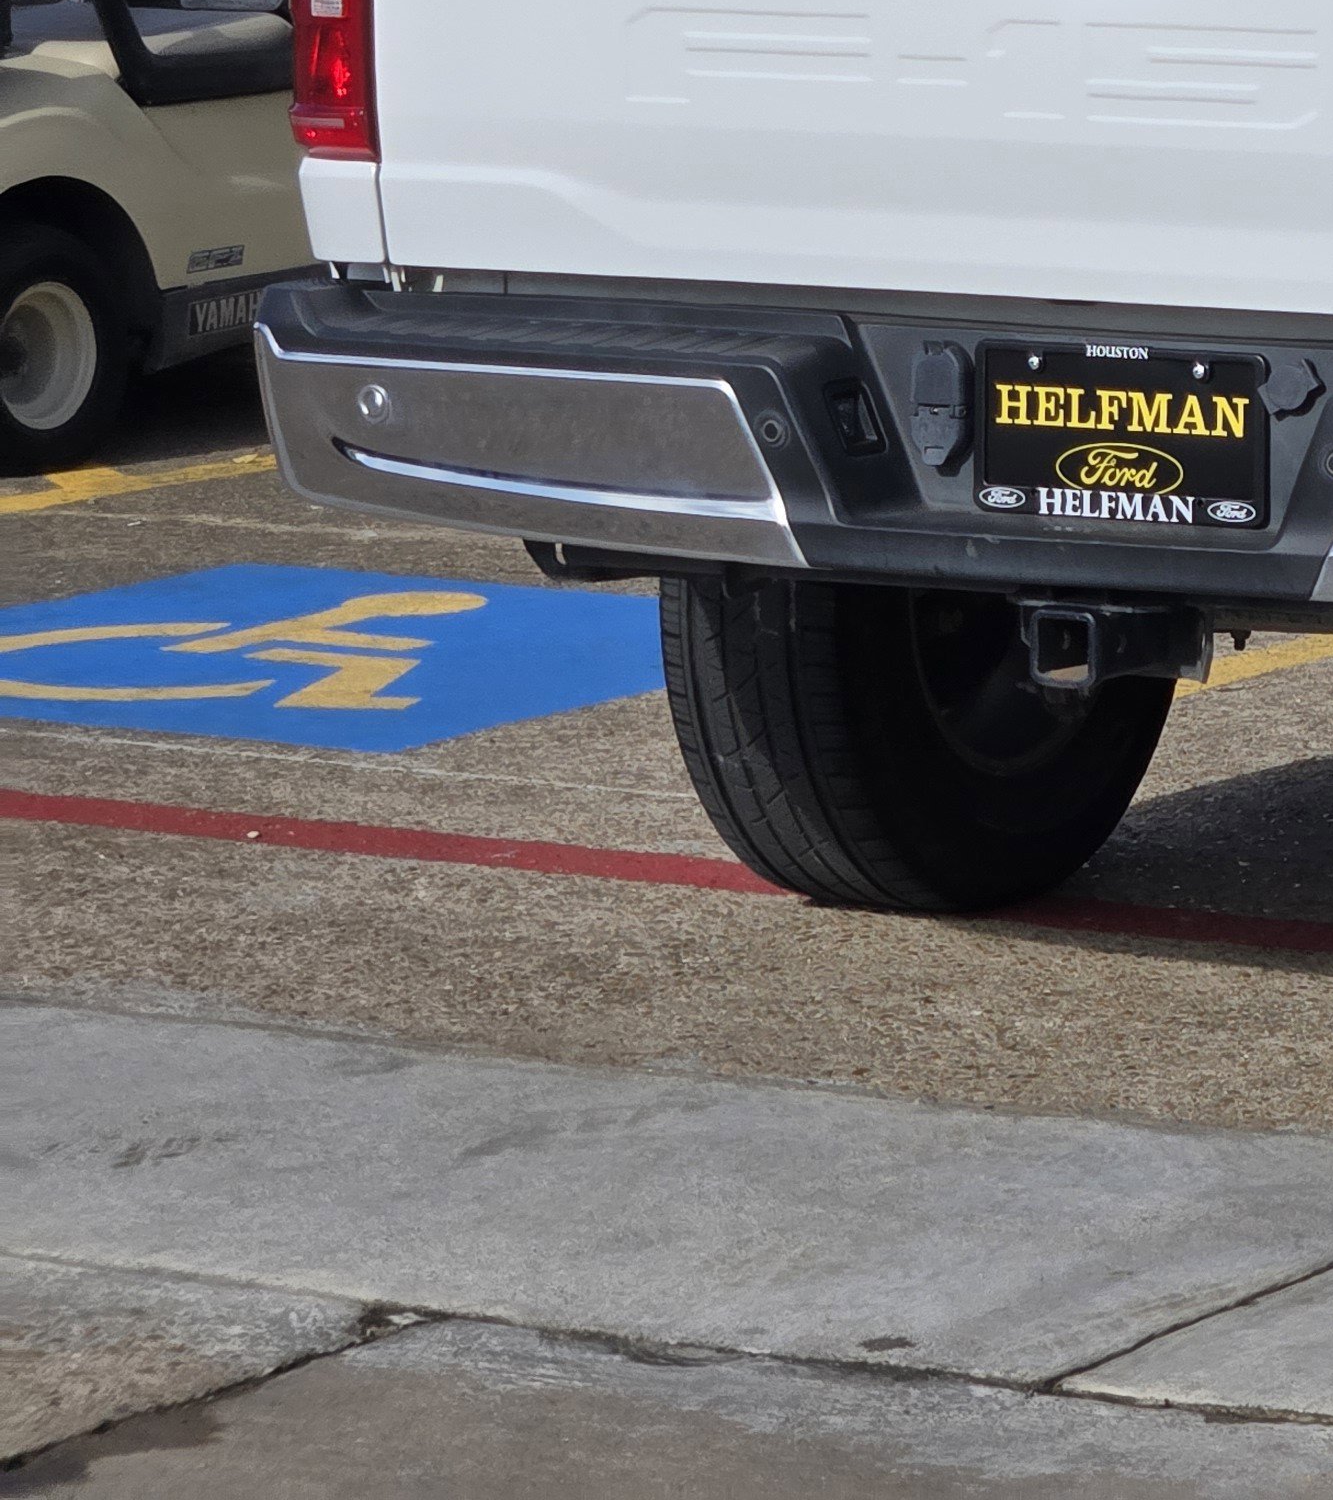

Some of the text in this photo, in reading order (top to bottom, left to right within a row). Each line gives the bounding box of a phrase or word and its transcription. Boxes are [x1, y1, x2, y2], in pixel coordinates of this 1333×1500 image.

[194, 290, 262, 333] YAMAH
[1085, 343, 1149, 360] HOUSTON
[994, 383, 1249, 438] HELFMAN
[1079, 446, 1157, 489] Ford
[1037, 486, 1195, 524] HELFMAN
